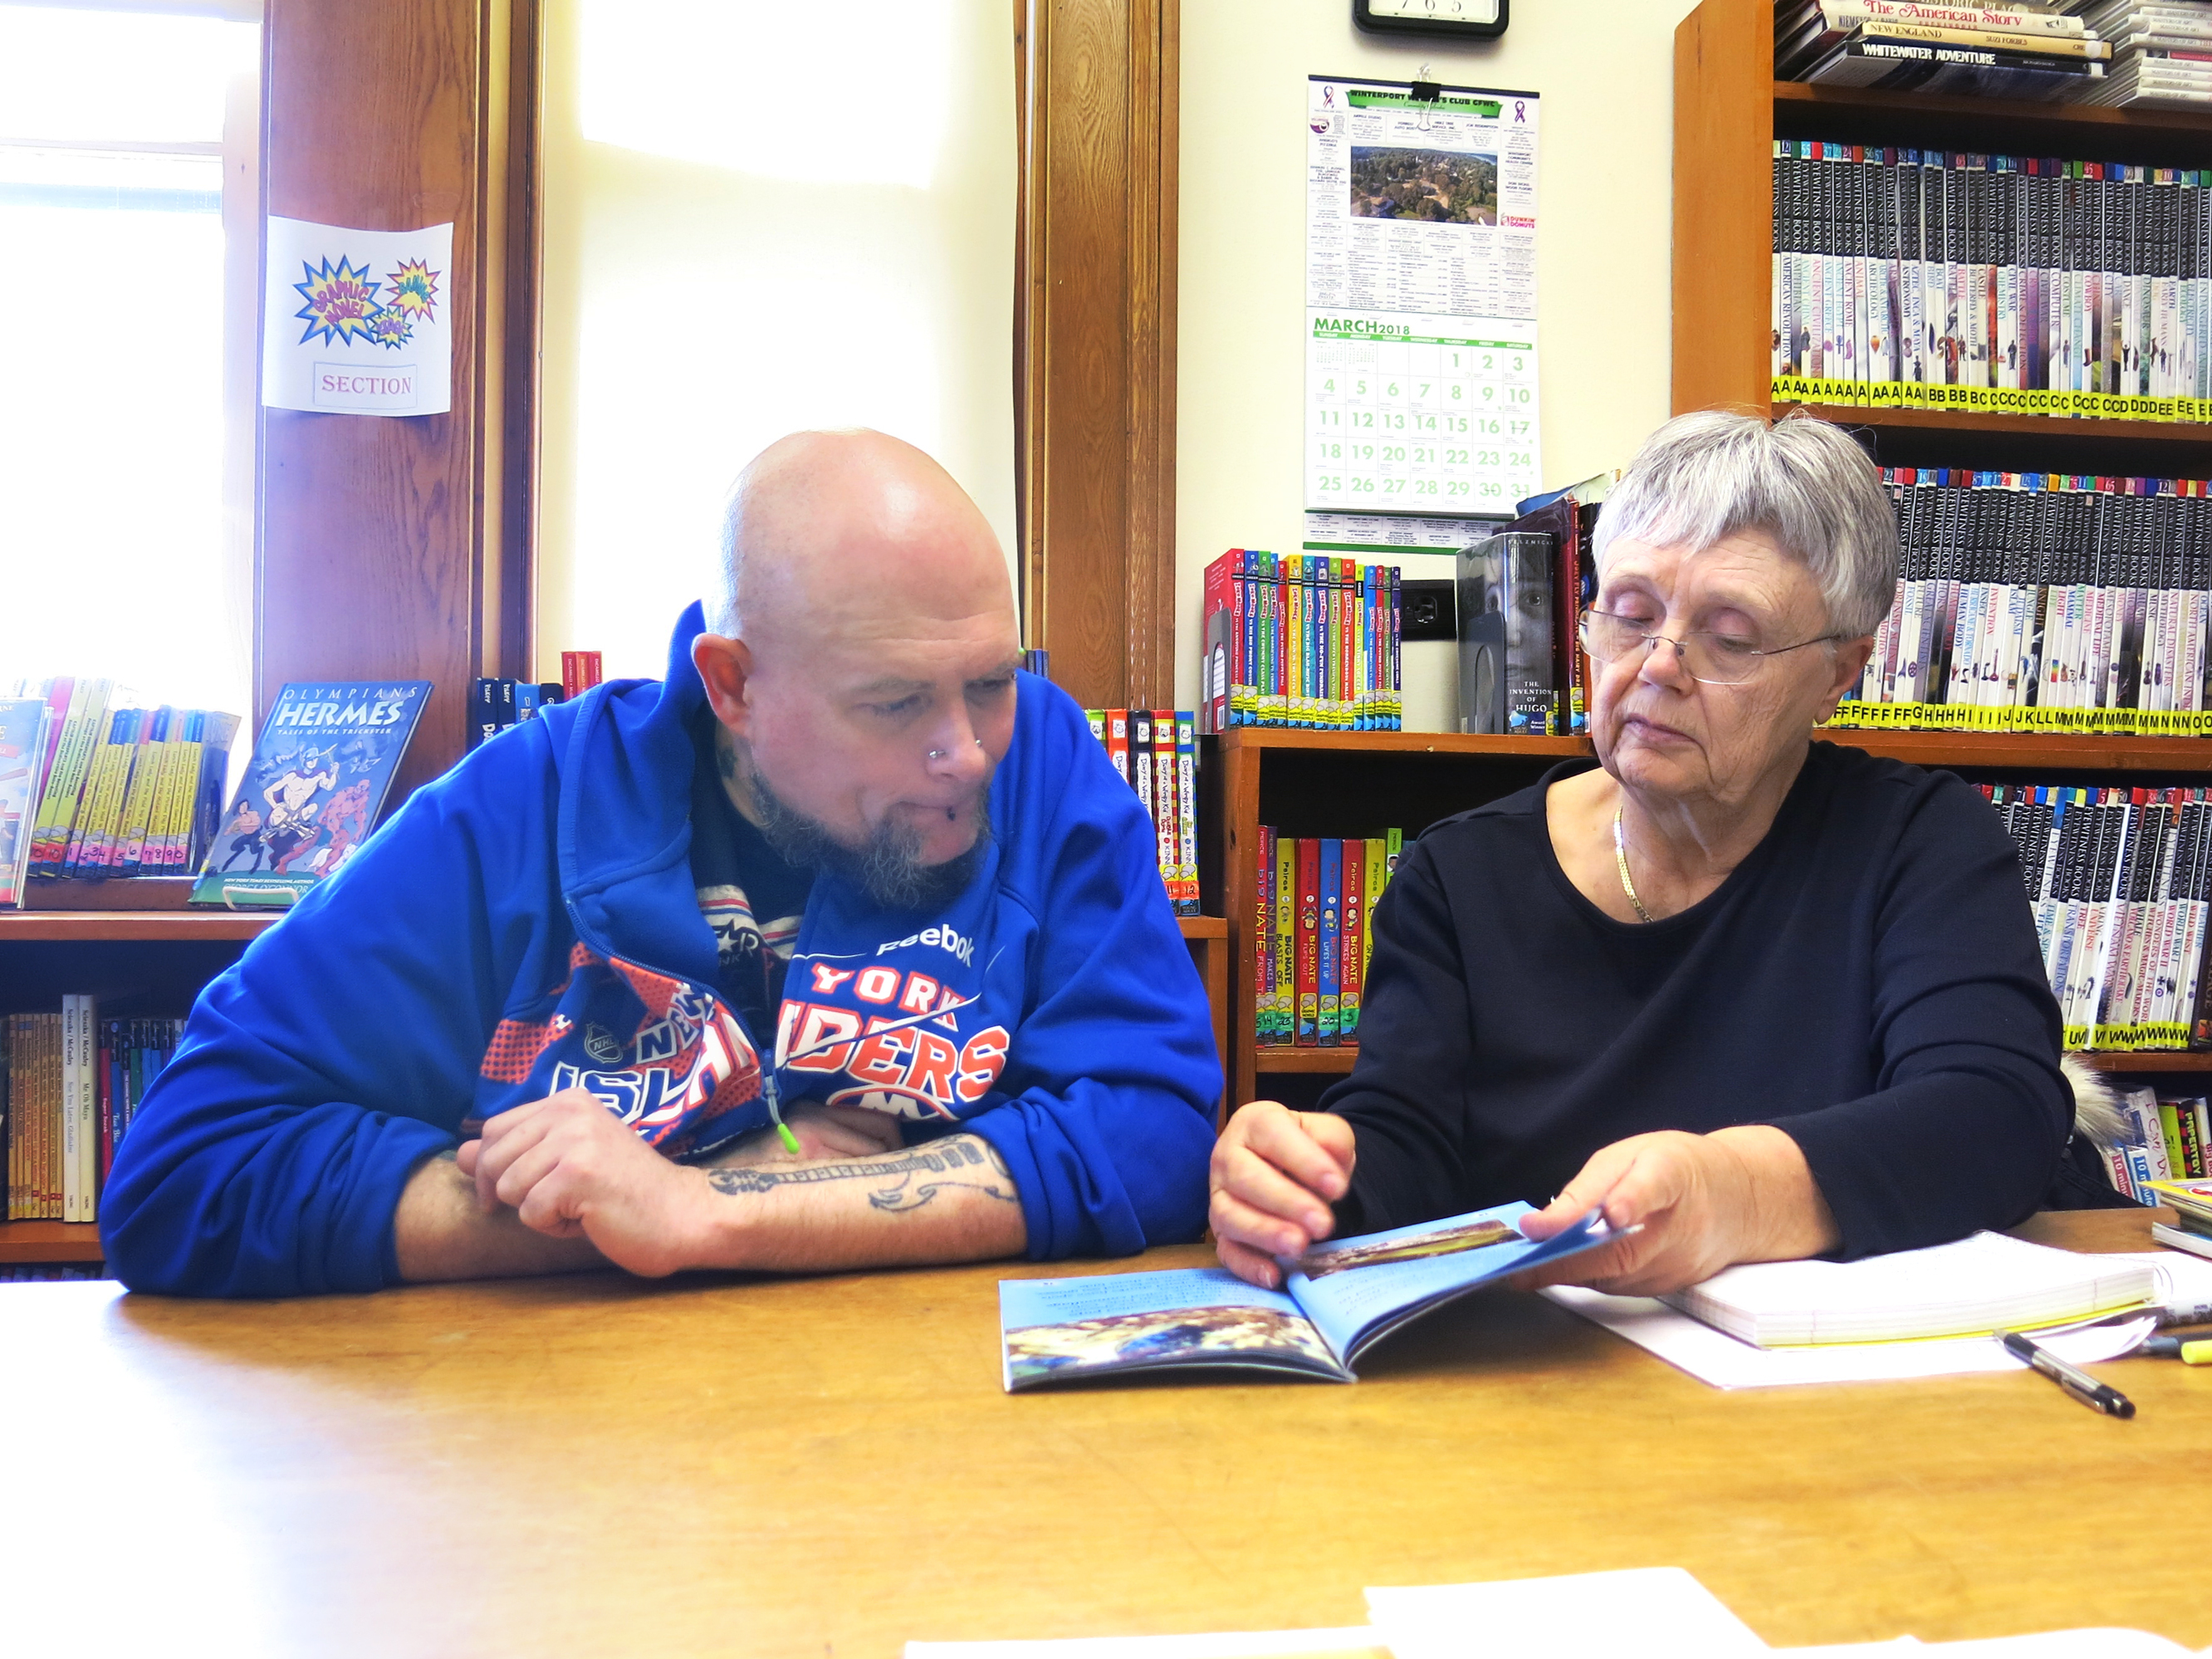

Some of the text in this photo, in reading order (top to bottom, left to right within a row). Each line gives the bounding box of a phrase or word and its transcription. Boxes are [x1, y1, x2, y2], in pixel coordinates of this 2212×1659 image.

[1863, 0, 1894, 14] The
[1899, 3, 1981, 22] American
[1982, 9, 2022, 26] Story
[1870, 23, 1894, 33] NEW
[1896, 25, 1942, 38] ENGLAND
[1862, 43, 1996, 65] WHITEWATER ADVENTURE
[1350, 90, 1405, 100] WINTERPORT
[1813, 162, 1821, 252] EYEWITNESS BOOKS
[1854, 165, 1863, 254] EYEWITNESS BOOKS
[312, 280, 369, 313] GRAPHIC
[2051, 272, 2060, 326] COMPUTER
[325, 296, 365, 326] NOVEL
[1314, 318, 1410, 335] MARCH 2018
[1453, 354, 1523, 371] 1 2 3
[321, 374, 411, 394] SECTION
[1324, 379, 1529, 403] 4 5 6 7 8 9 10
[1320, 410, 1530, 435] 11 12 13 14 15 16 17
[1320, 443, 1531, 467] 18 19 20 21 22 23 24
[1319, 477, 1530, 498] 25 26 27 28 29 30 31
[1929, 488, 1946, 578] EYEWITNESS BOOKS
[1953, 489, 1970, 578] EYEWITNESS BOOKS
[283, 687, 418, 700] OLYMPIANS
[275, 701, 404, 727] HERMES
[129, 846, 136, 855] 6
[154, 849, 162, 859] 8
[167, 850, 173, 860] 9
[2119, 806, 2140, 897] EYEWITNESS BOOKS
[1186, 885, 1195, 895] 12
[1256, 903, 1266, 952] NATE
[875, 923, 975, 968] Reebok
[1285, 936, 1293, 985] BIG NATE
[1323, 971, 1329, 979] UP
[811, 962, 967, 1032] YORK
[636, 981, 715, 1064] NEW
[1264, 1016, 1272, 1025] 14
[1345, 1013, 1353, 1021] 3
[592, 1035, 617, 1050] NHL
[2185, 1112, 2201, 1174] PAPERTOY
[2114, 1156, 2129, 1197] 10 minu
[2136, 1158, 2146, 1171] 10
